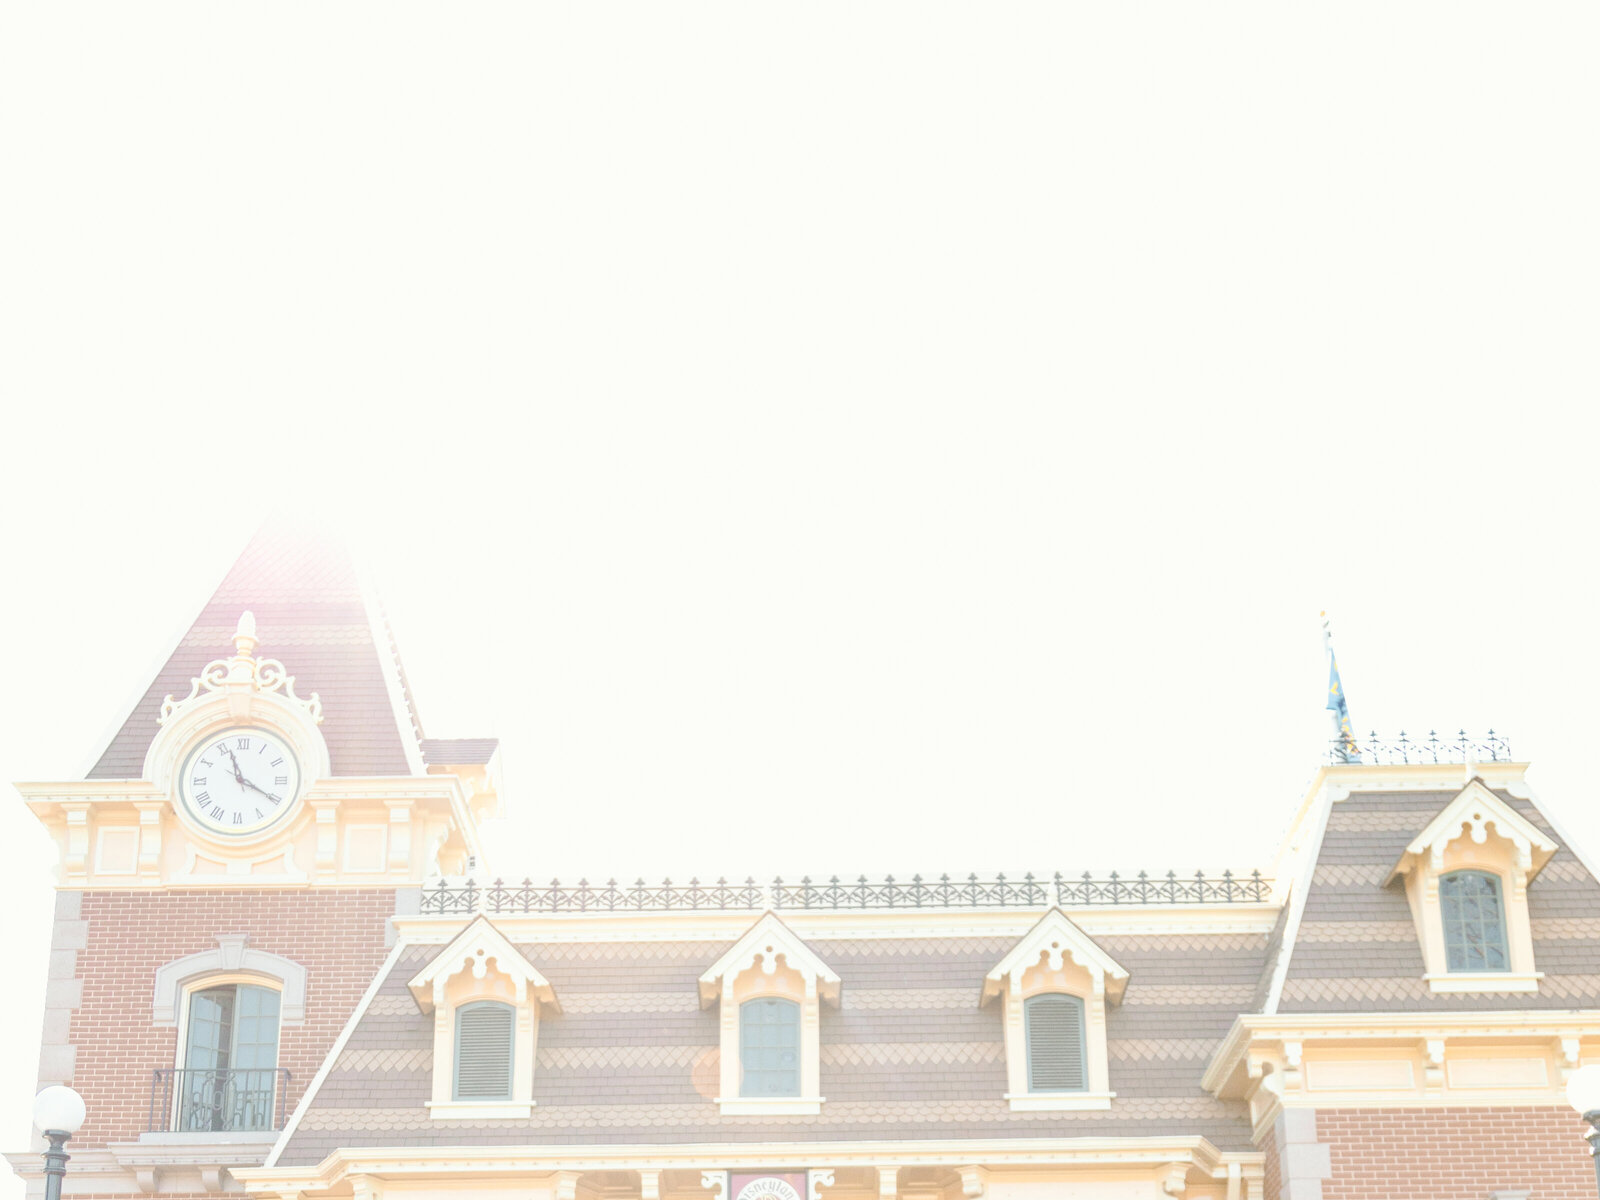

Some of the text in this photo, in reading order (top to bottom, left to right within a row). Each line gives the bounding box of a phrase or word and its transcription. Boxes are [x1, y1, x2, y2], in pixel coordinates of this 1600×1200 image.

[237, 738, 250, 750] XII
[200, 758, 213, 768] X
[270, 757, 283, 767] II
[193, 777, 207, 785] IX
[275, 776, 287, 785] III
[195, 791, 212, 808] VIII
[210, 806, 225, 821] VII
[233, 812, 242, 824] VI
[255, 808, 264, 819] V
